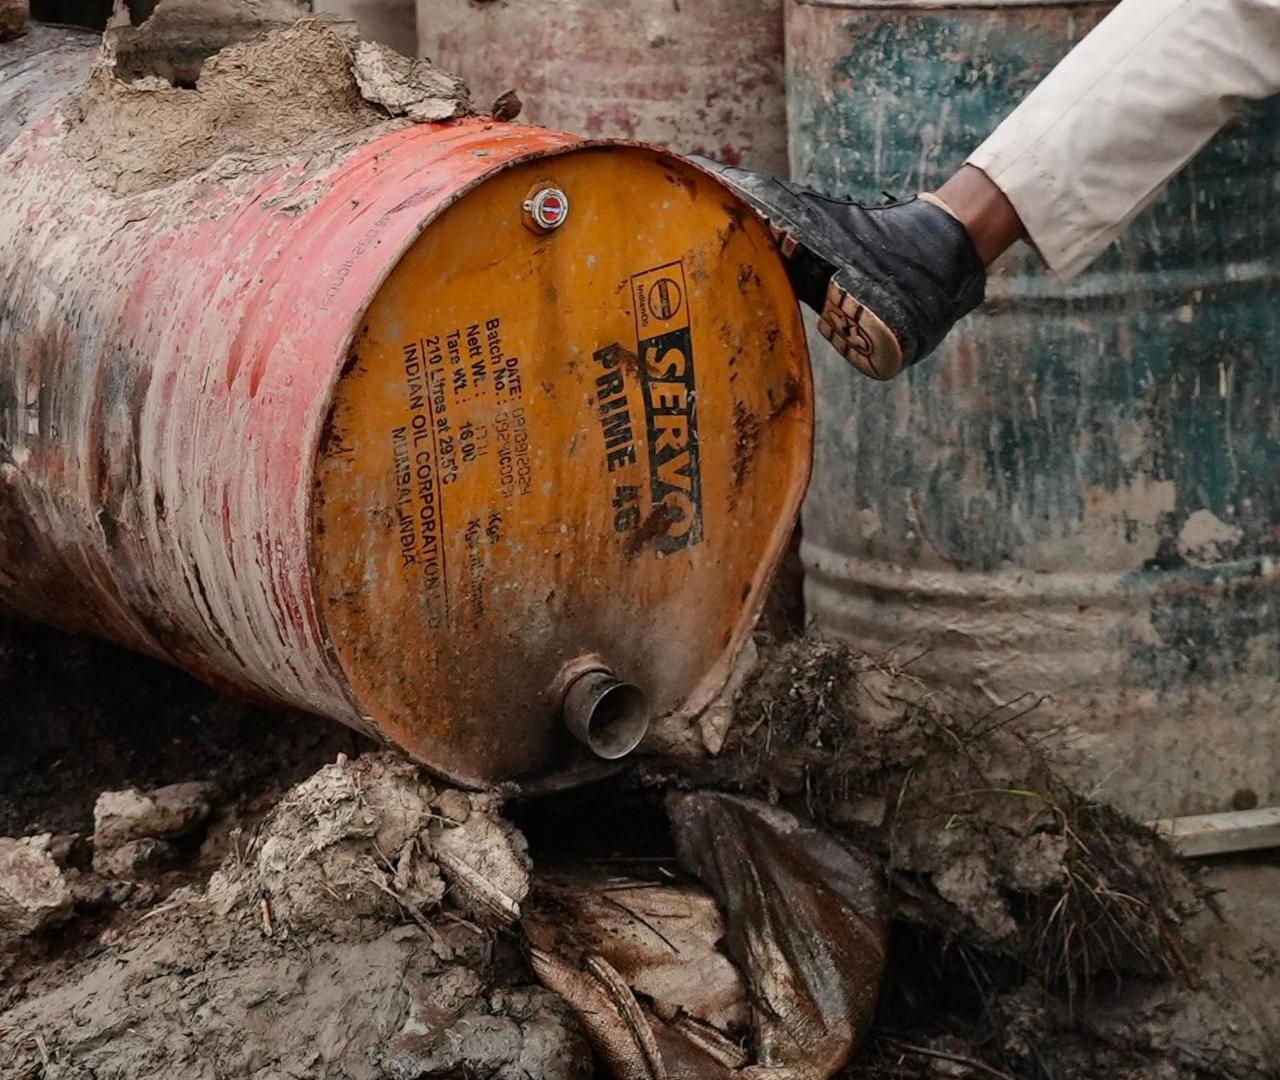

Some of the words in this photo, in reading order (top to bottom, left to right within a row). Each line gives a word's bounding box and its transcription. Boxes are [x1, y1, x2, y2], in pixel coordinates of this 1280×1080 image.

[447, 329, 460, 365] Tare
[466, 324, 482, 359] Nett
[485, 318, 504, 365] Batch
[403, 342, 425, 410] INDIAN
[426, 336, 442, 365] 210
[437, 418, 449, 434] at
[505, 357, 522, 400] DATE:
[411, 414, 428, 448] OIL
[592, 342, 636, 472] PRIME
[645, 346, 695, 538] SERVO
[415, 451, 440, 591] CORPORATION
[613, 485, 641, 533] 46
